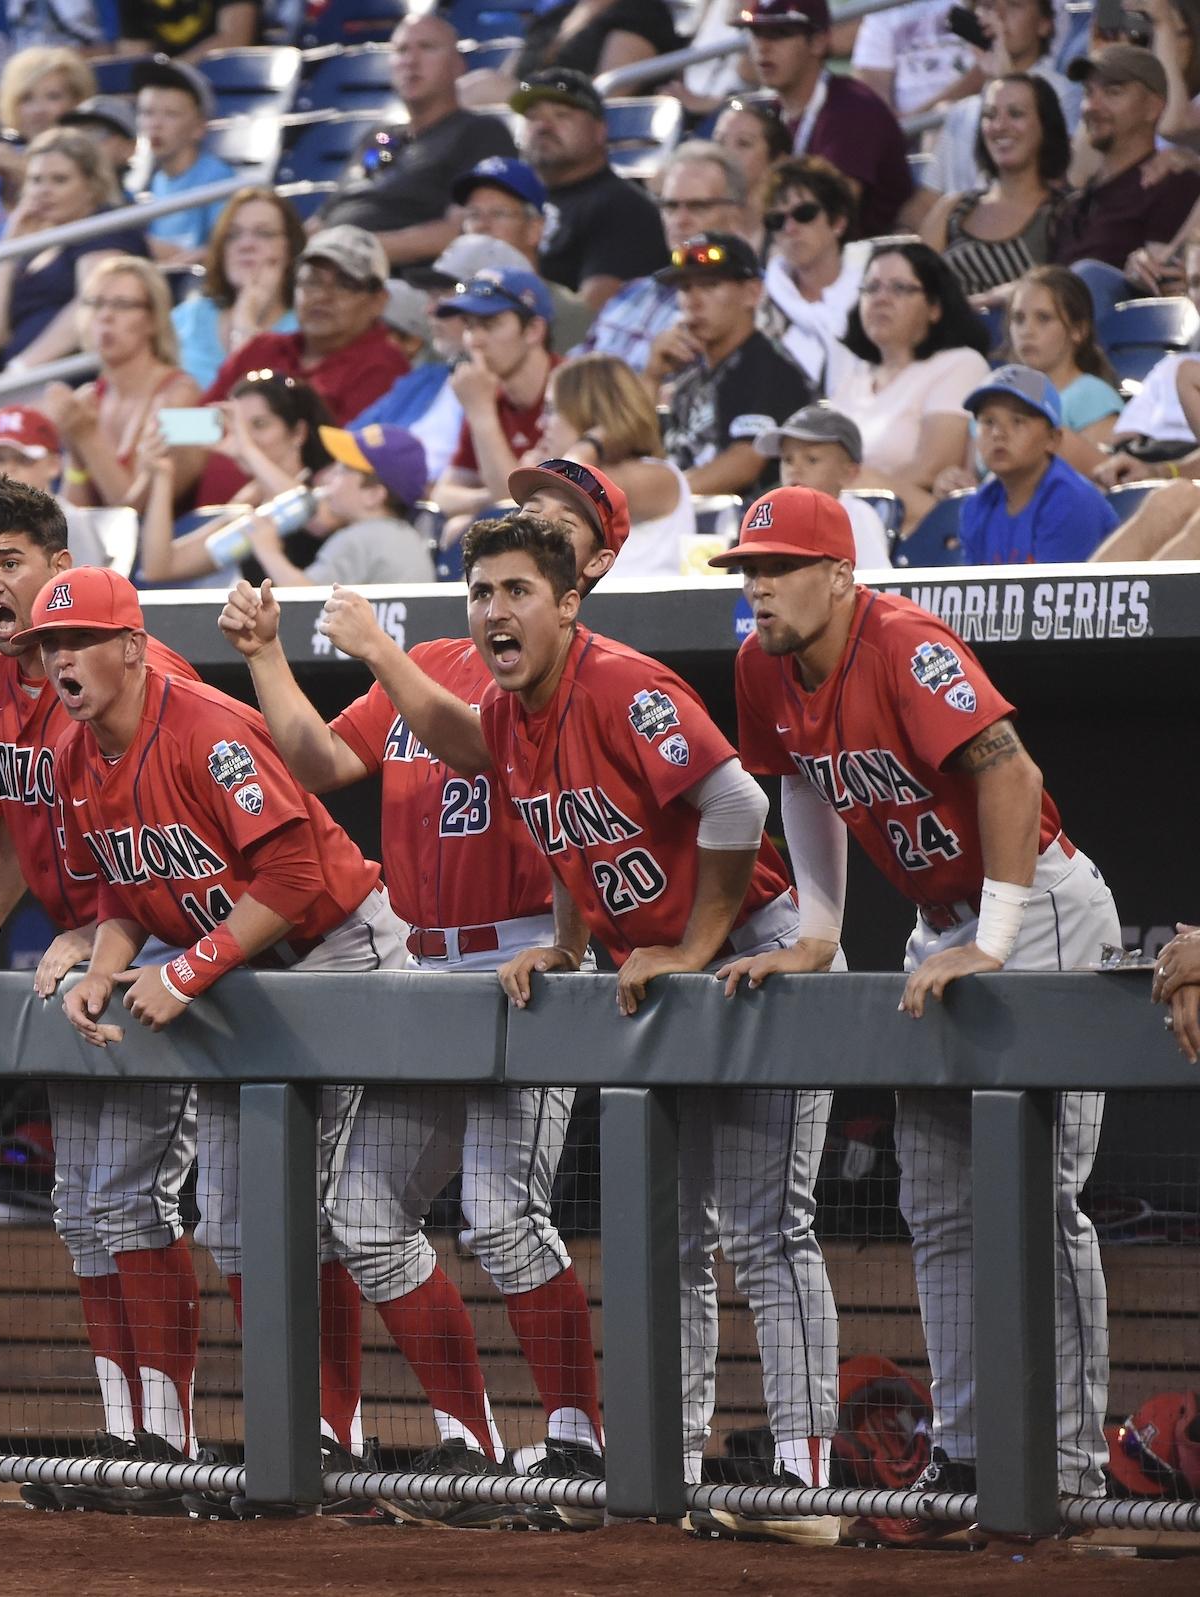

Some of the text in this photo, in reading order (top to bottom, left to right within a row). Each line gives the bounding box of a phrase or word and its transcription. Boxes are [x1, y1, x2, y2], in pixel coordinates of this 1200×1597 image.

[747, 501, 773, 530] A
[45, 583, 74, 612] A
[911, 580, 1151, 642] WORLD SERIES
[790, 749, 934, 812] IZONA
[511, 785, 644, 856] IZONA
[887, 810, 963, 871] 24
[592, 847, 668, 916] 20
